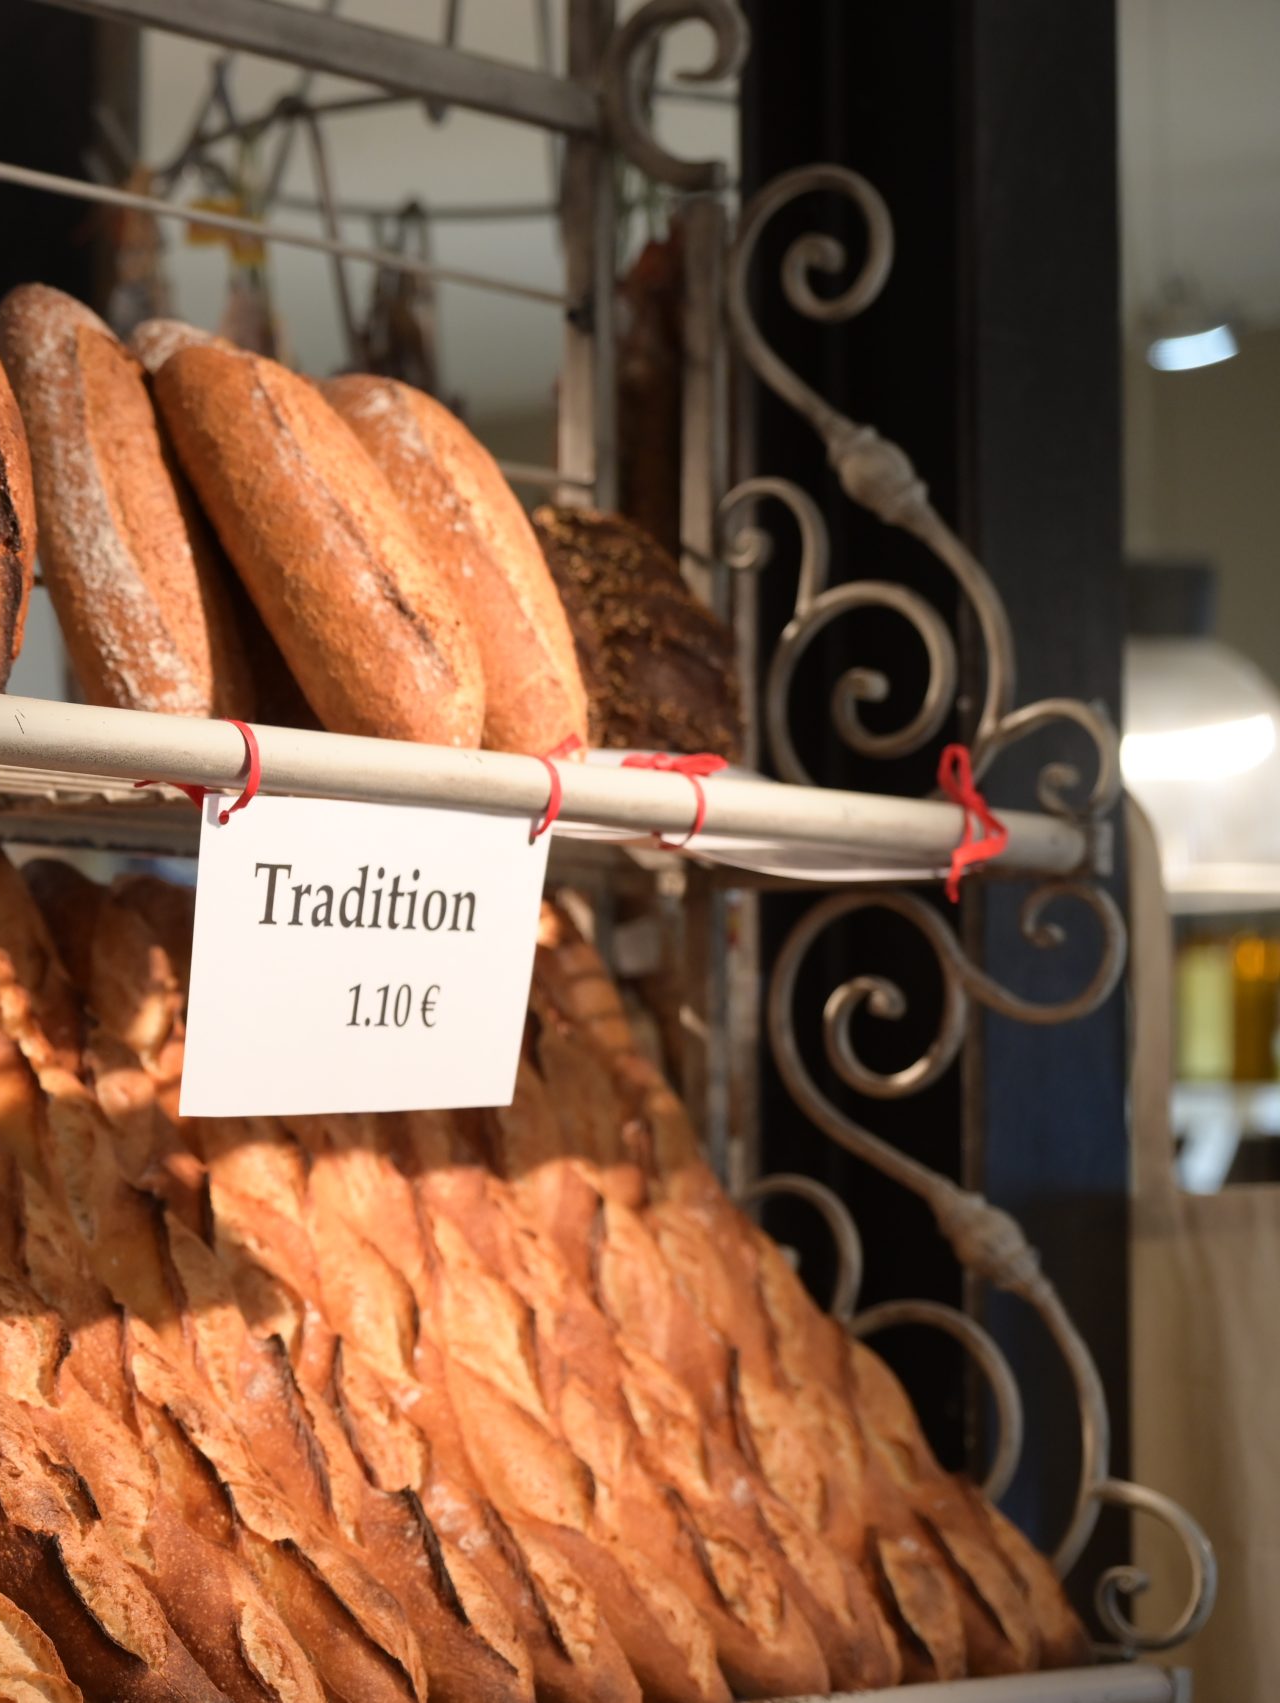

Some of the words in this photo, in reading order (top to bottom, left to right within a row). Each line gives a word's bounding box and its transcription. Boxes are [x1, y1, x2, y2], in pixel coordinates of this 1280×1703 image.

[254, 863, 477, 932] Tradition
[346, 984, 412, 1027] 1.10
[421, 985, 441, 1028] €
